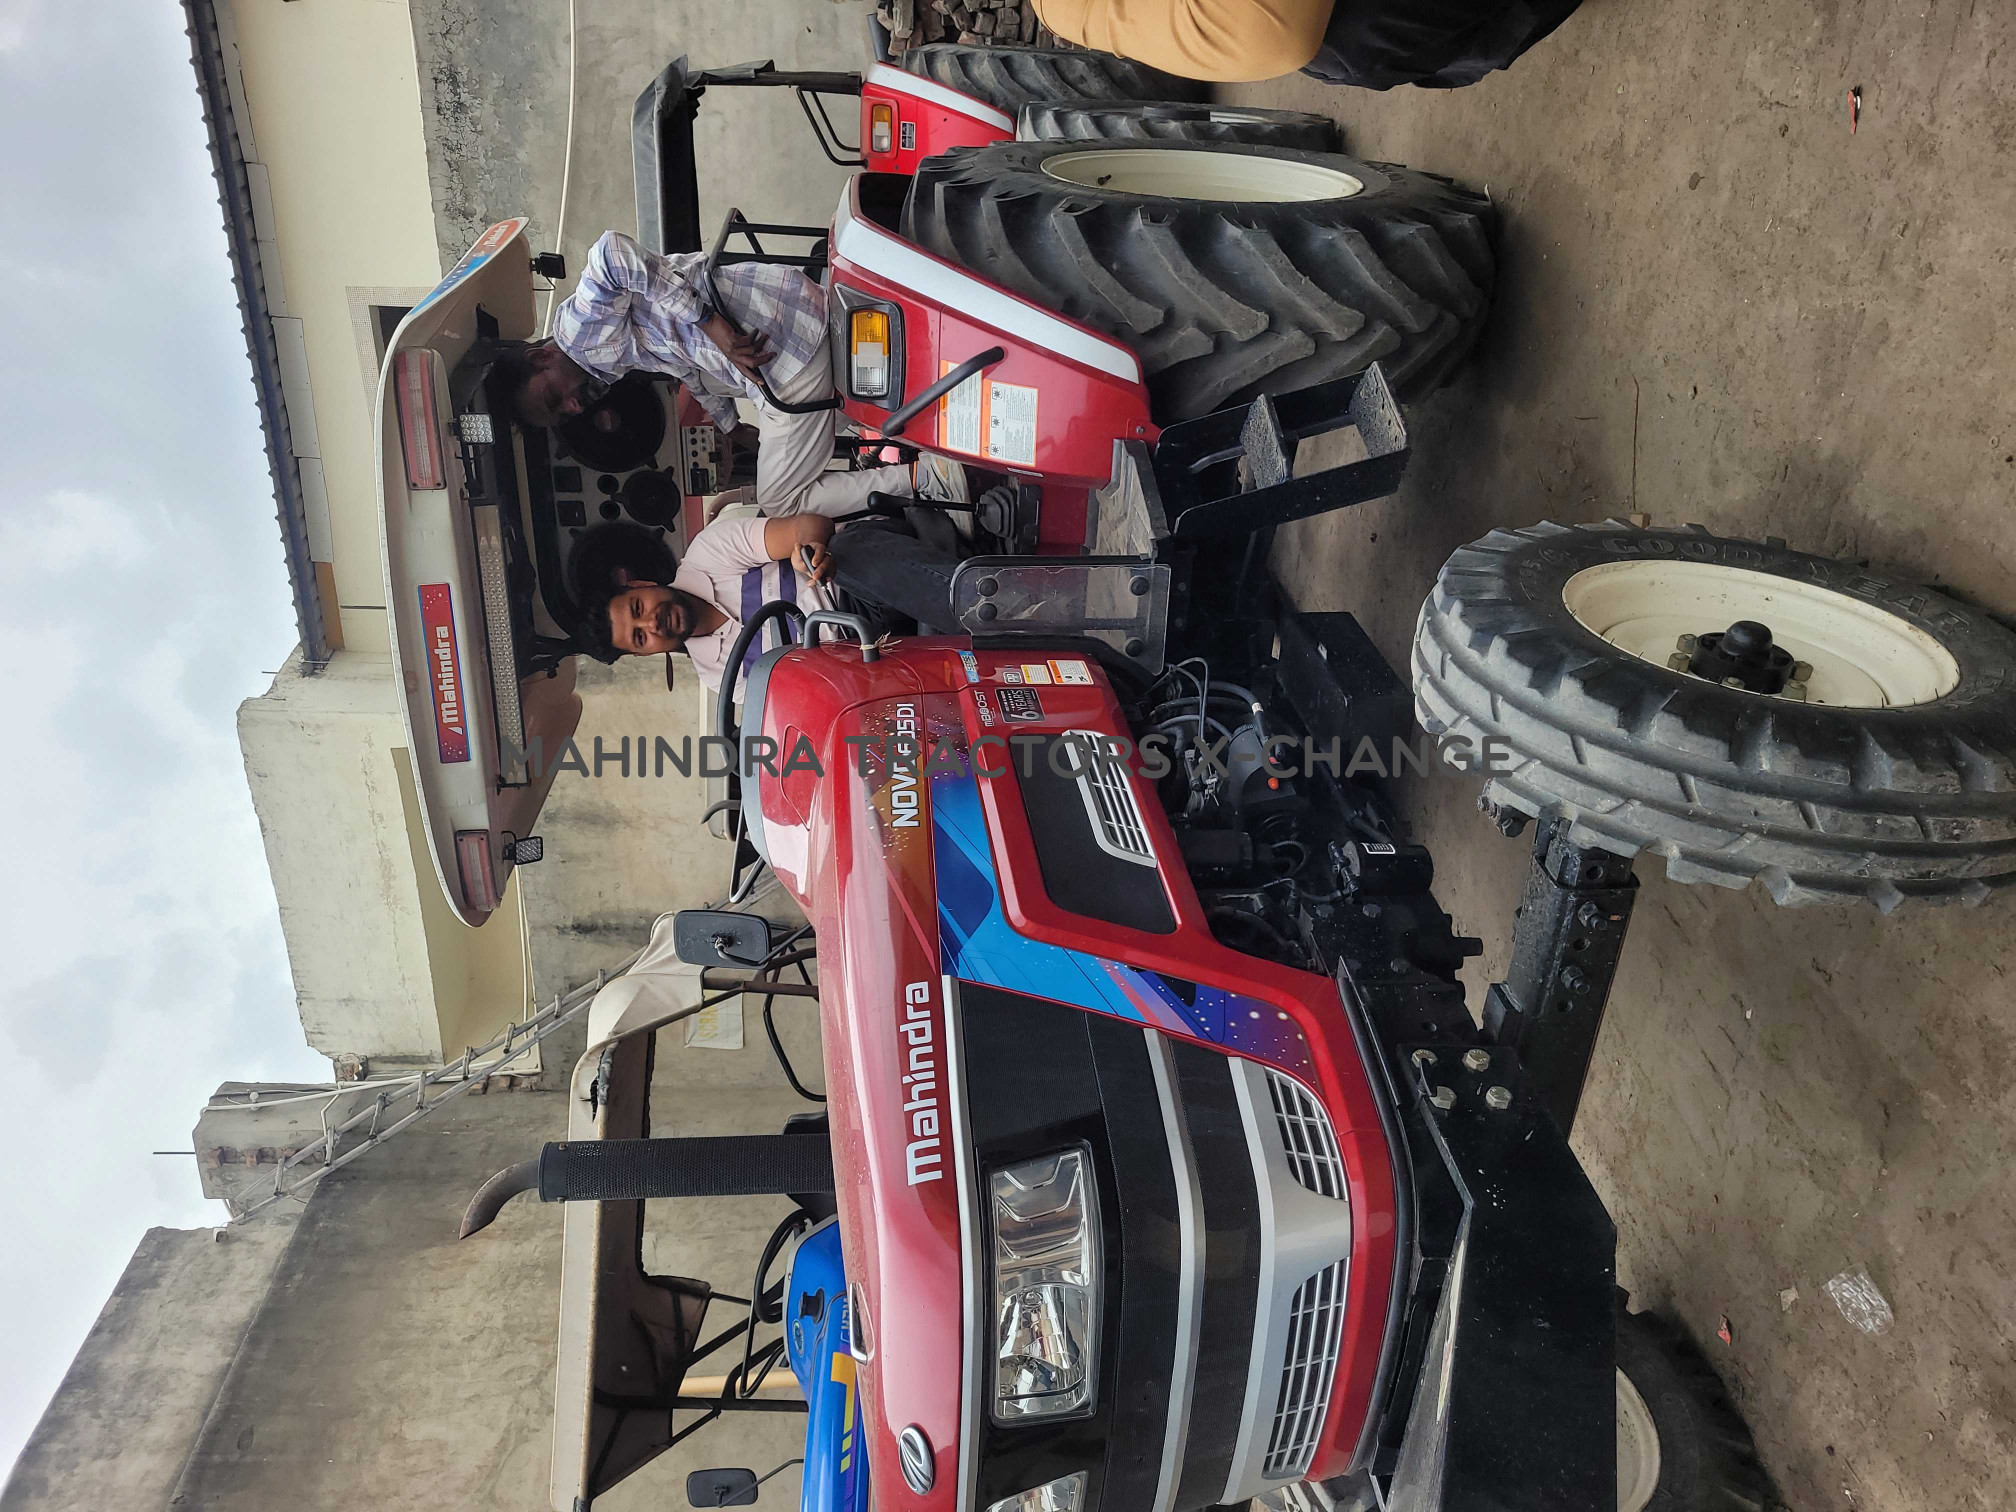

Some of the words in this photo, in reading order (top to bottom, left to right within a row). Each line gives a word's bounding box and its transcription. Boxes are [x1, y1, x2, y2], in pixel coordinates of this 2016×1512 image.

[433, 626, 459, 724] Mahindra
[1011, 690, 1028, 711] YEARS
[1010, 711, 1040, 720] 6
[899, 981, 943, 1186] Mahindra
